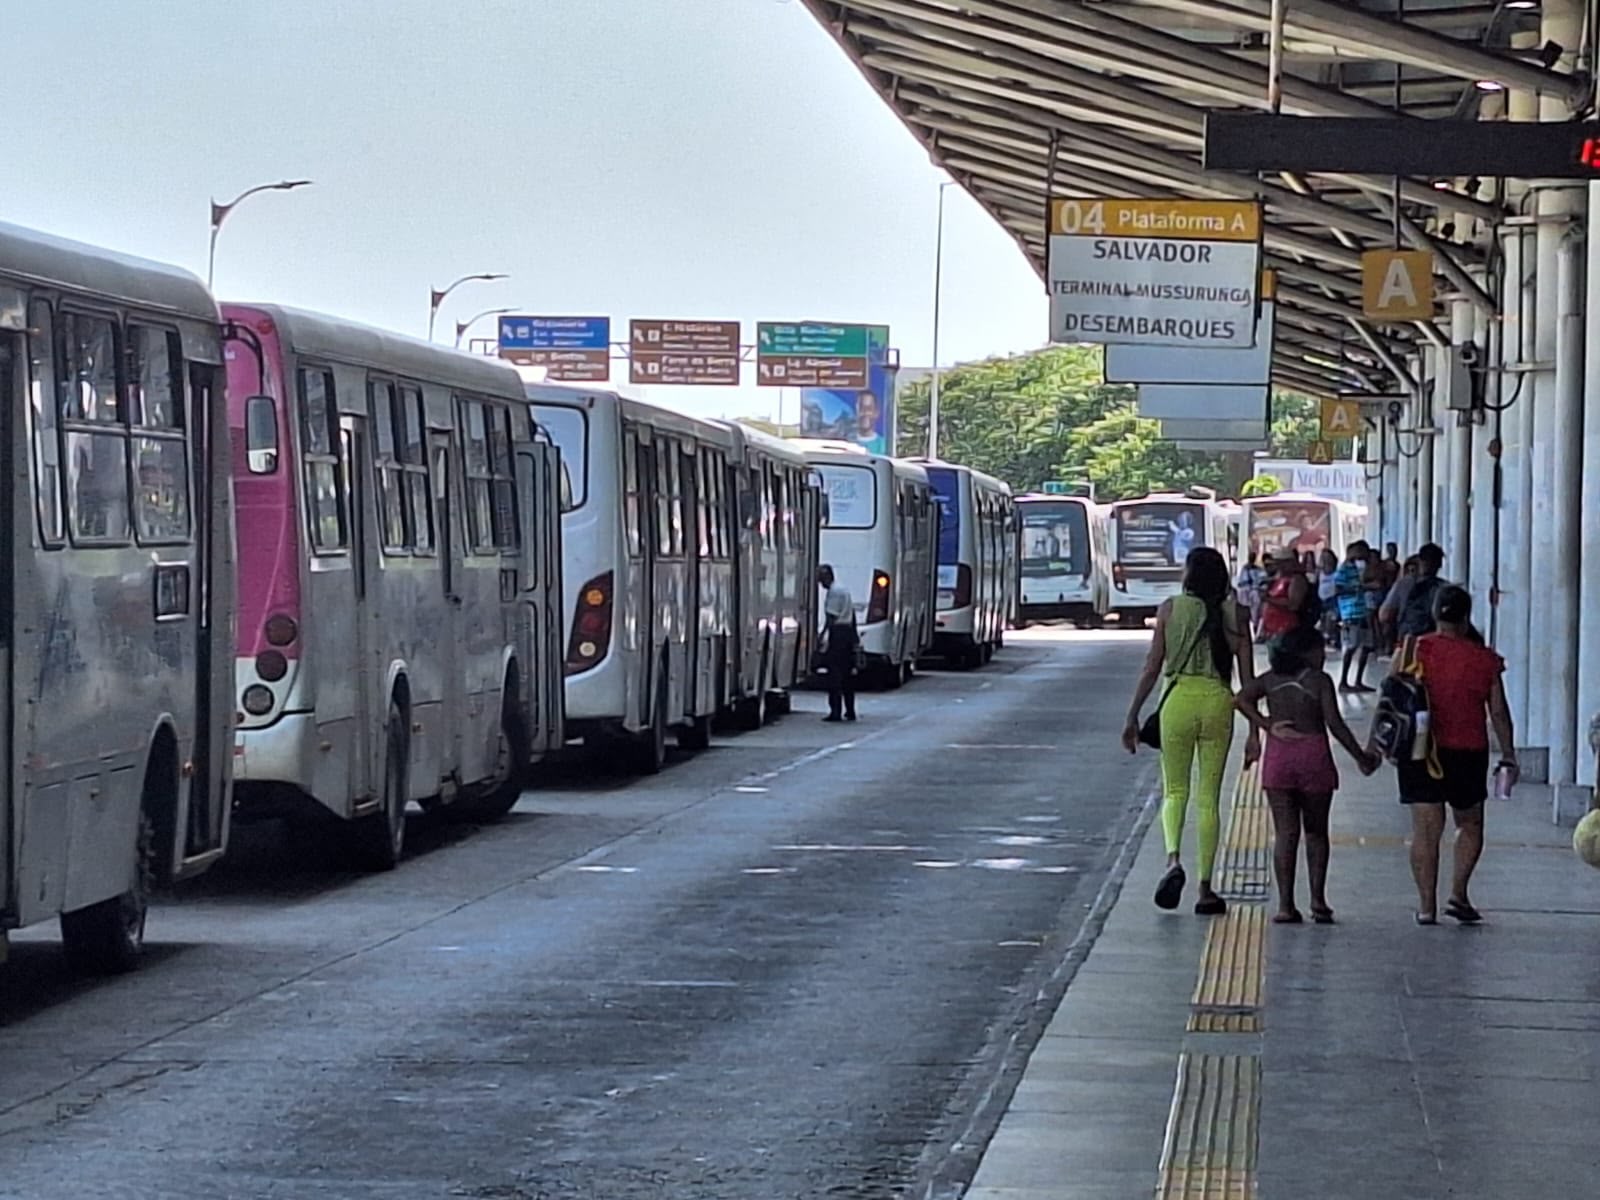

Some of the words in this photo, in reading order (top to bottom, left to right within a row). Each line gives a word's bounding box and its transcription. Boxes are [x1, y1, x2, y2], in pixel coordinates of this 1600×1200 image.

[1060, 201, 1105, 235] 04
[1118, 209, 1225, 232] Plataforma
[1231, 213, 1246, 232] A
[1093, 240, 1212, 263] SALVADOR
[1377, 258, 1417, 308] A
[1065, 313, 1236, 340] DESEMBARQUES
[1329, 405, 1351, 430] A
[1313, 442, 1328, 460] A
